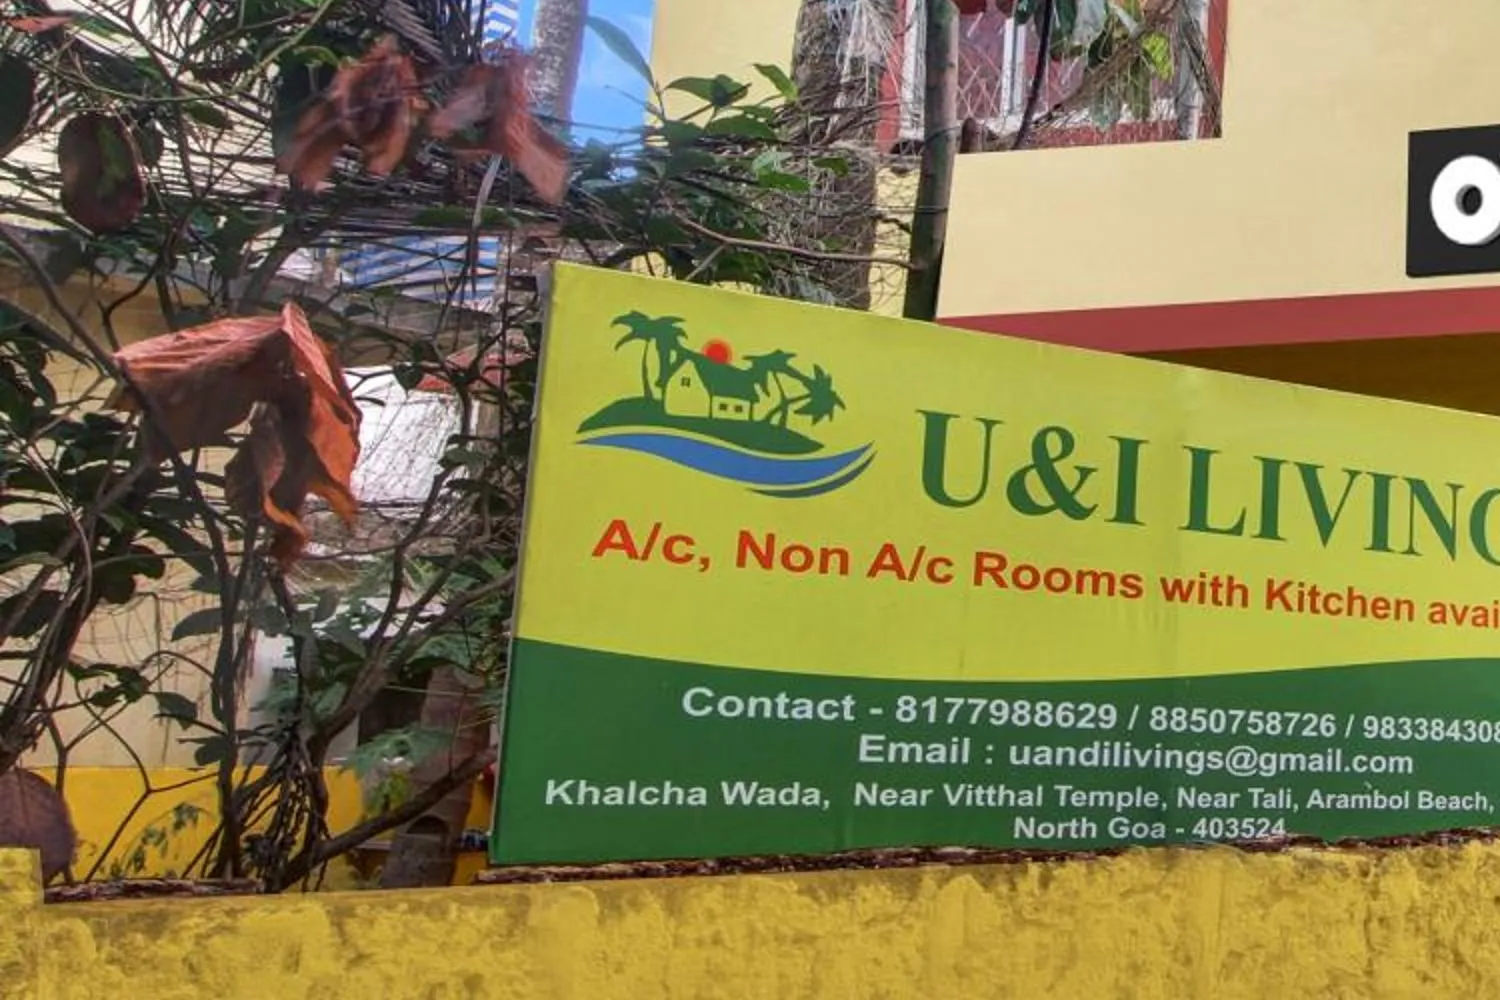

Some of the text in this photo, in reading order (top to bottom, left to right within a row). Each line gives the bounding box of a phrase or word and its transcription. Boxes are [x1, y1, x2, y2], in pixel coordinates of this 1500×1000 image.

[915, 409, 1148, 526] U&I
[591, 519, 711, 572] A/c,
[735, 529, 850, 577] Non
[866, 542, 954, 585] A/c
[973, 551, 1144, 600] Rooms
[1160, 571, 1249, 608] with
[1265, 578, 1415, 621] Kitchen
[683, 687, 855, 721] Contact
[895, 695, 1117, 729] 8177988629
[1149, 706, 1336, 737] 8850758726
[859, 734, 970, 763] Email
[1009, 741, 1413, 777] uandilivings@gmail.com
[545, 779, 707, 806] Khalcha
[721, 781, 830, 809] Wada,
[855, 782, 933, 806] Near
[943, 783, 1043, 807] Vitthal
[1054, 785, 1167, 813] Temple,
[1177, 787, 1240, 809] Near
[1247, 787, 1299, 813] Tali,
[1306, 789, 1409, 811] Arambol
[1417, 790, 1494, 812] Beach,
[1014, 817, 1097, 839] North
[1108, 816, 1165, 839] Goa
[1192, 817, 1286, 839] 403524
